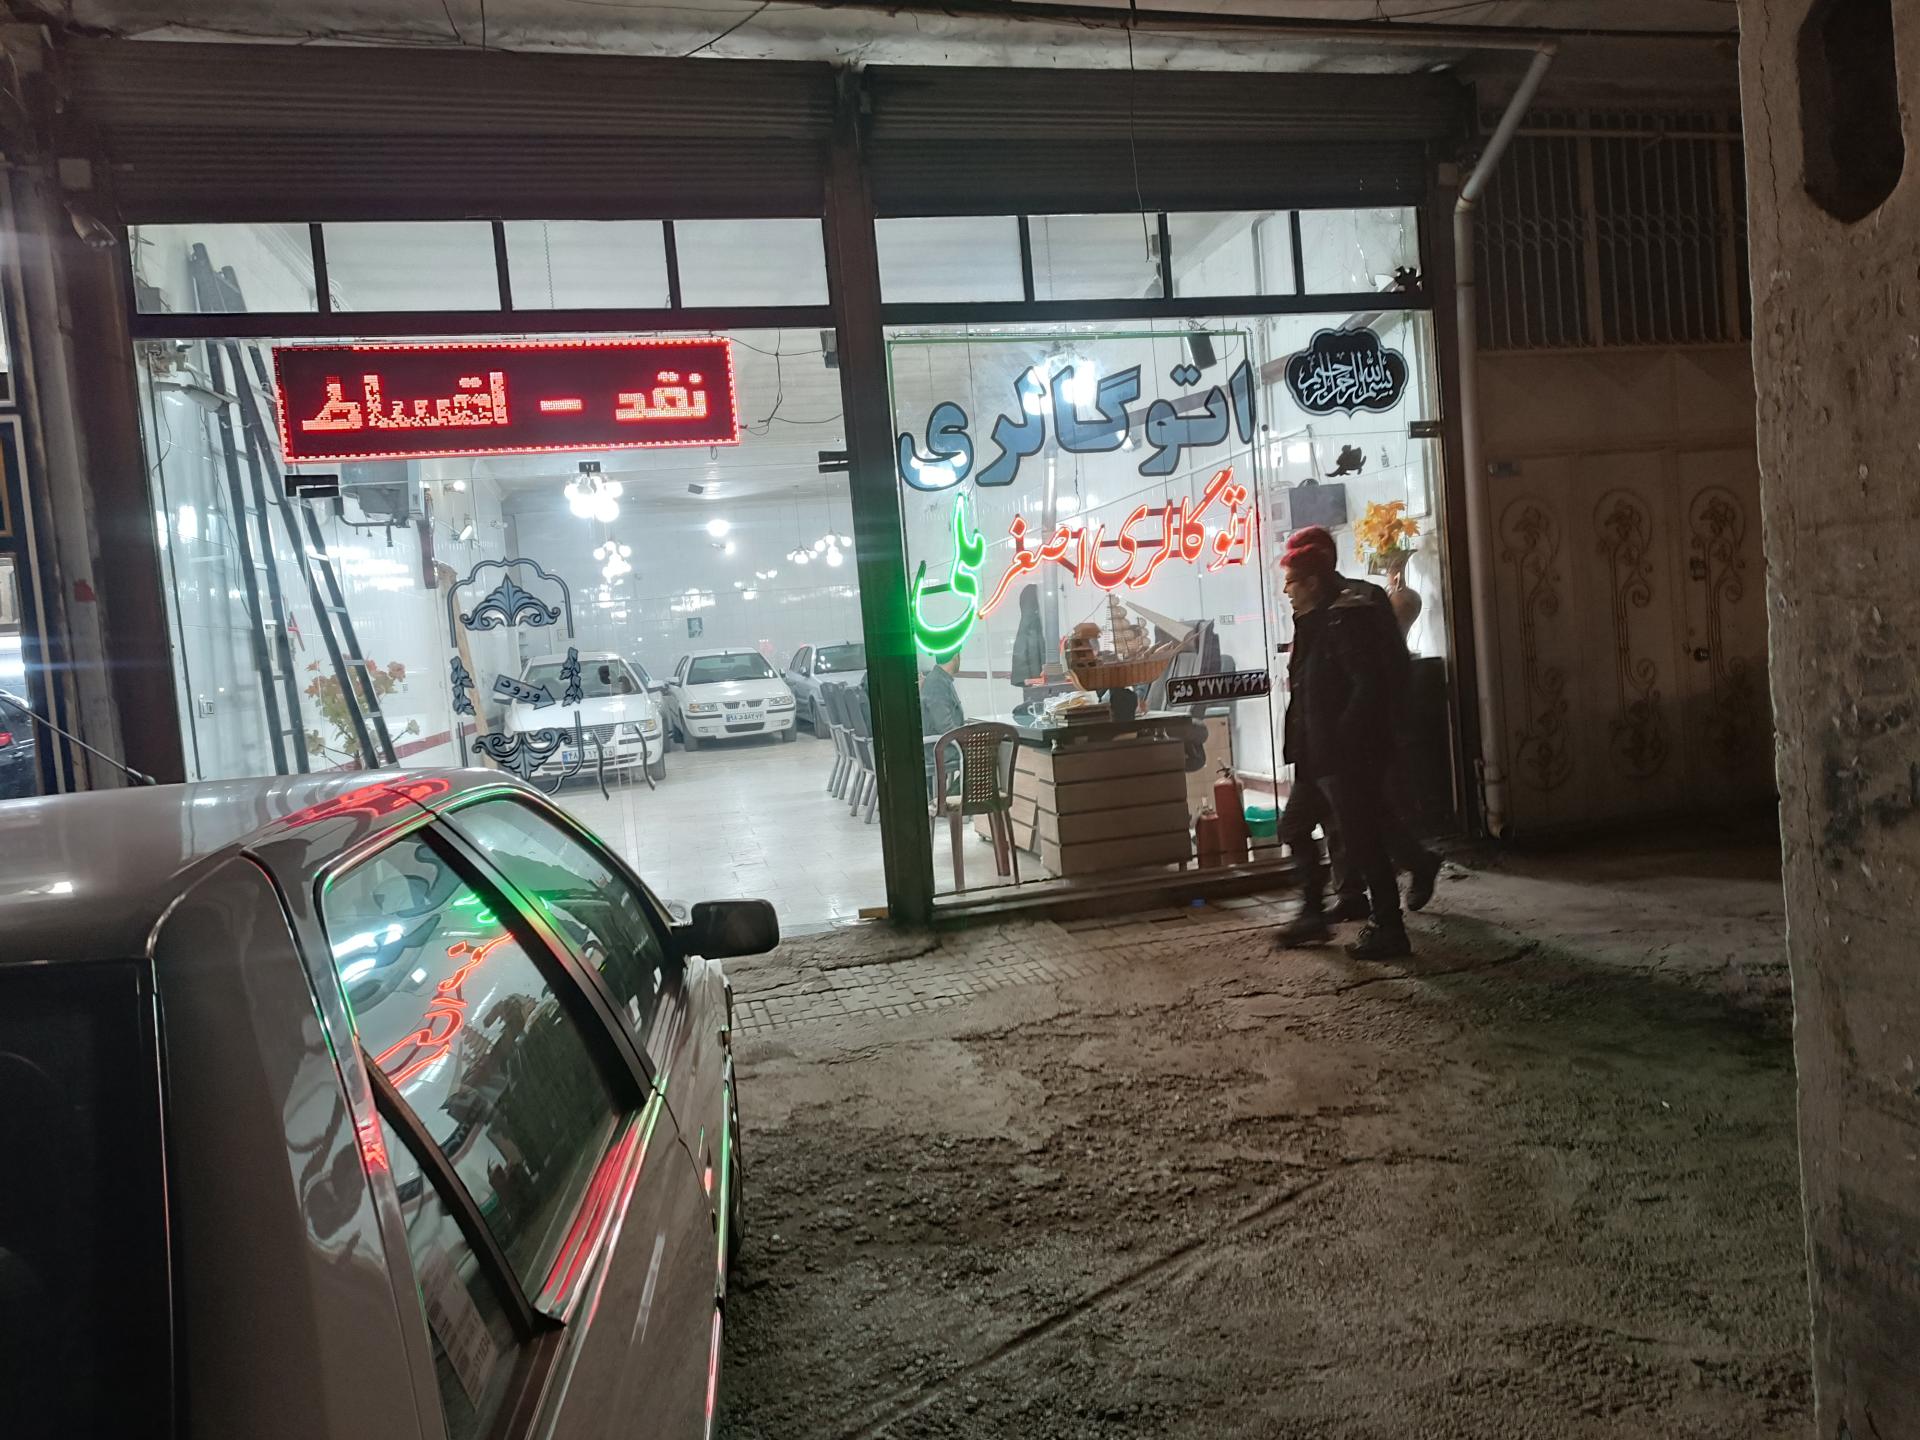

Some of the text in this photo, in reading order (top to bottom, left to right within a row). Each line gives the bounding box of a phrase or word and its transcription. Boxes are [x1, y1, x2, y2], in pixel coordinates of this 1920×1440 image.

[614, 370, 708, 420] نقد
[896, 357, 1256, 492] اتو گالری
[500, 680, 541, 702] ورود
[1171, 680, 1195, 703] دفتر
